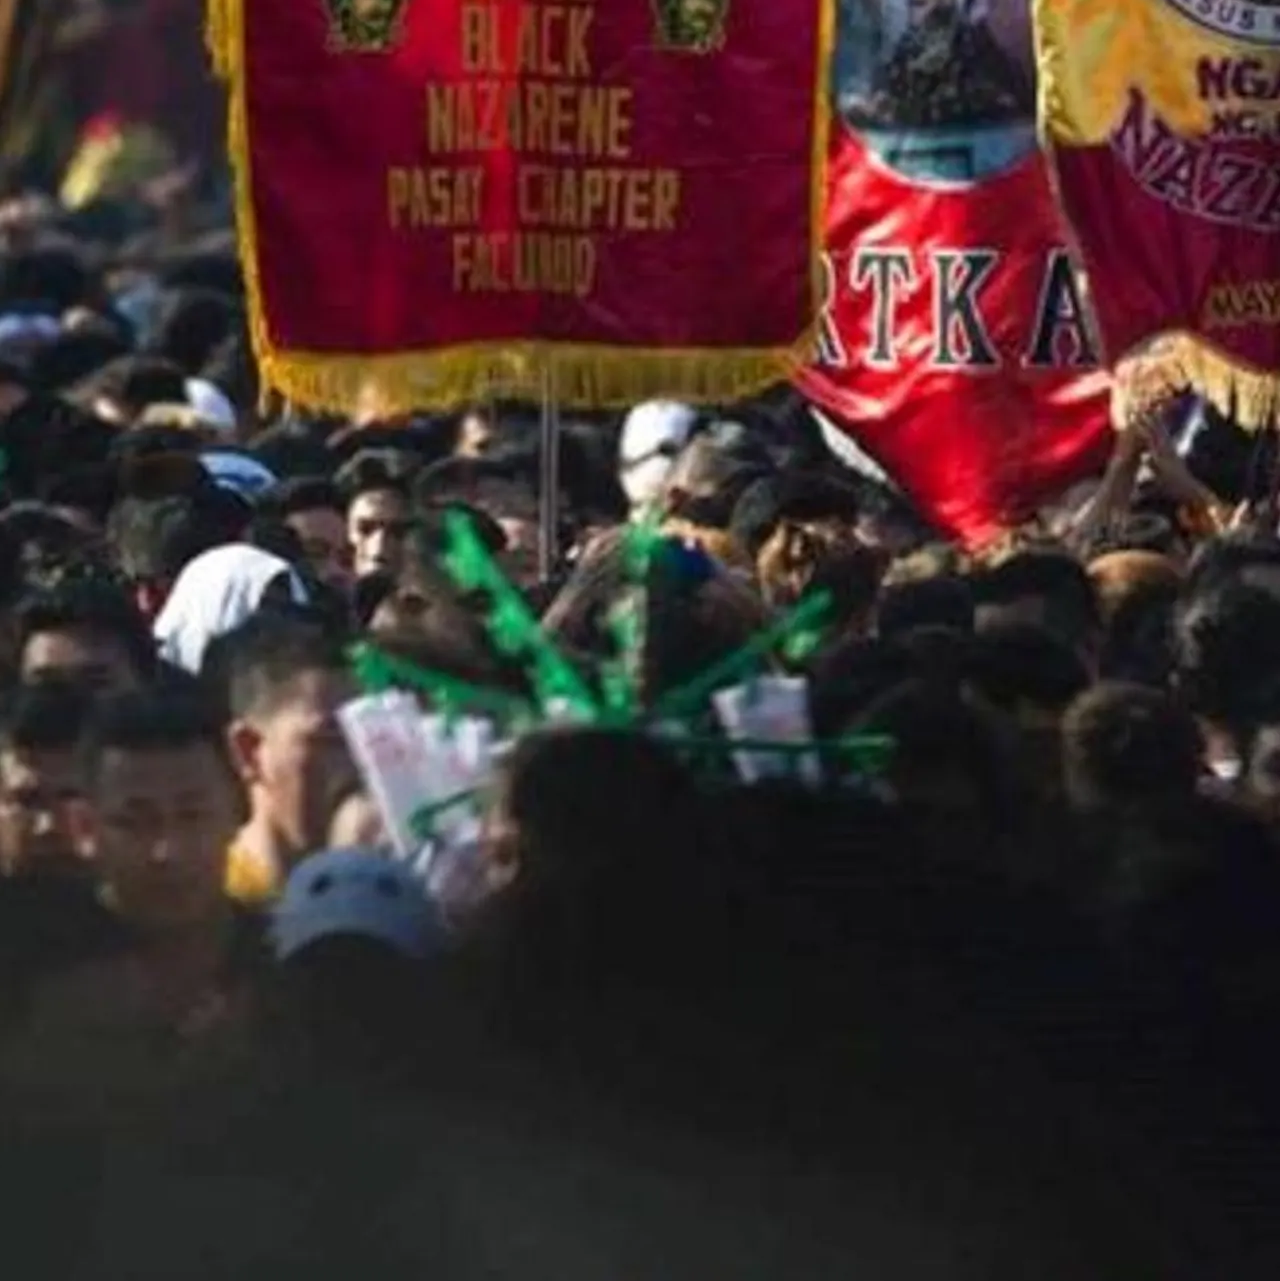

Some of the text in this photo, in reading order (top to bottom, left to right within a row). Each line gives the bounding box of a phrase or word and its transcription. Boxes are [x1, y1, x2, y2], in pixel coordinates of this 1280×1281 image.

[460, 3, 597, 79] BLACK
[386, 163, 683, 232] PASAY CHAPTER
